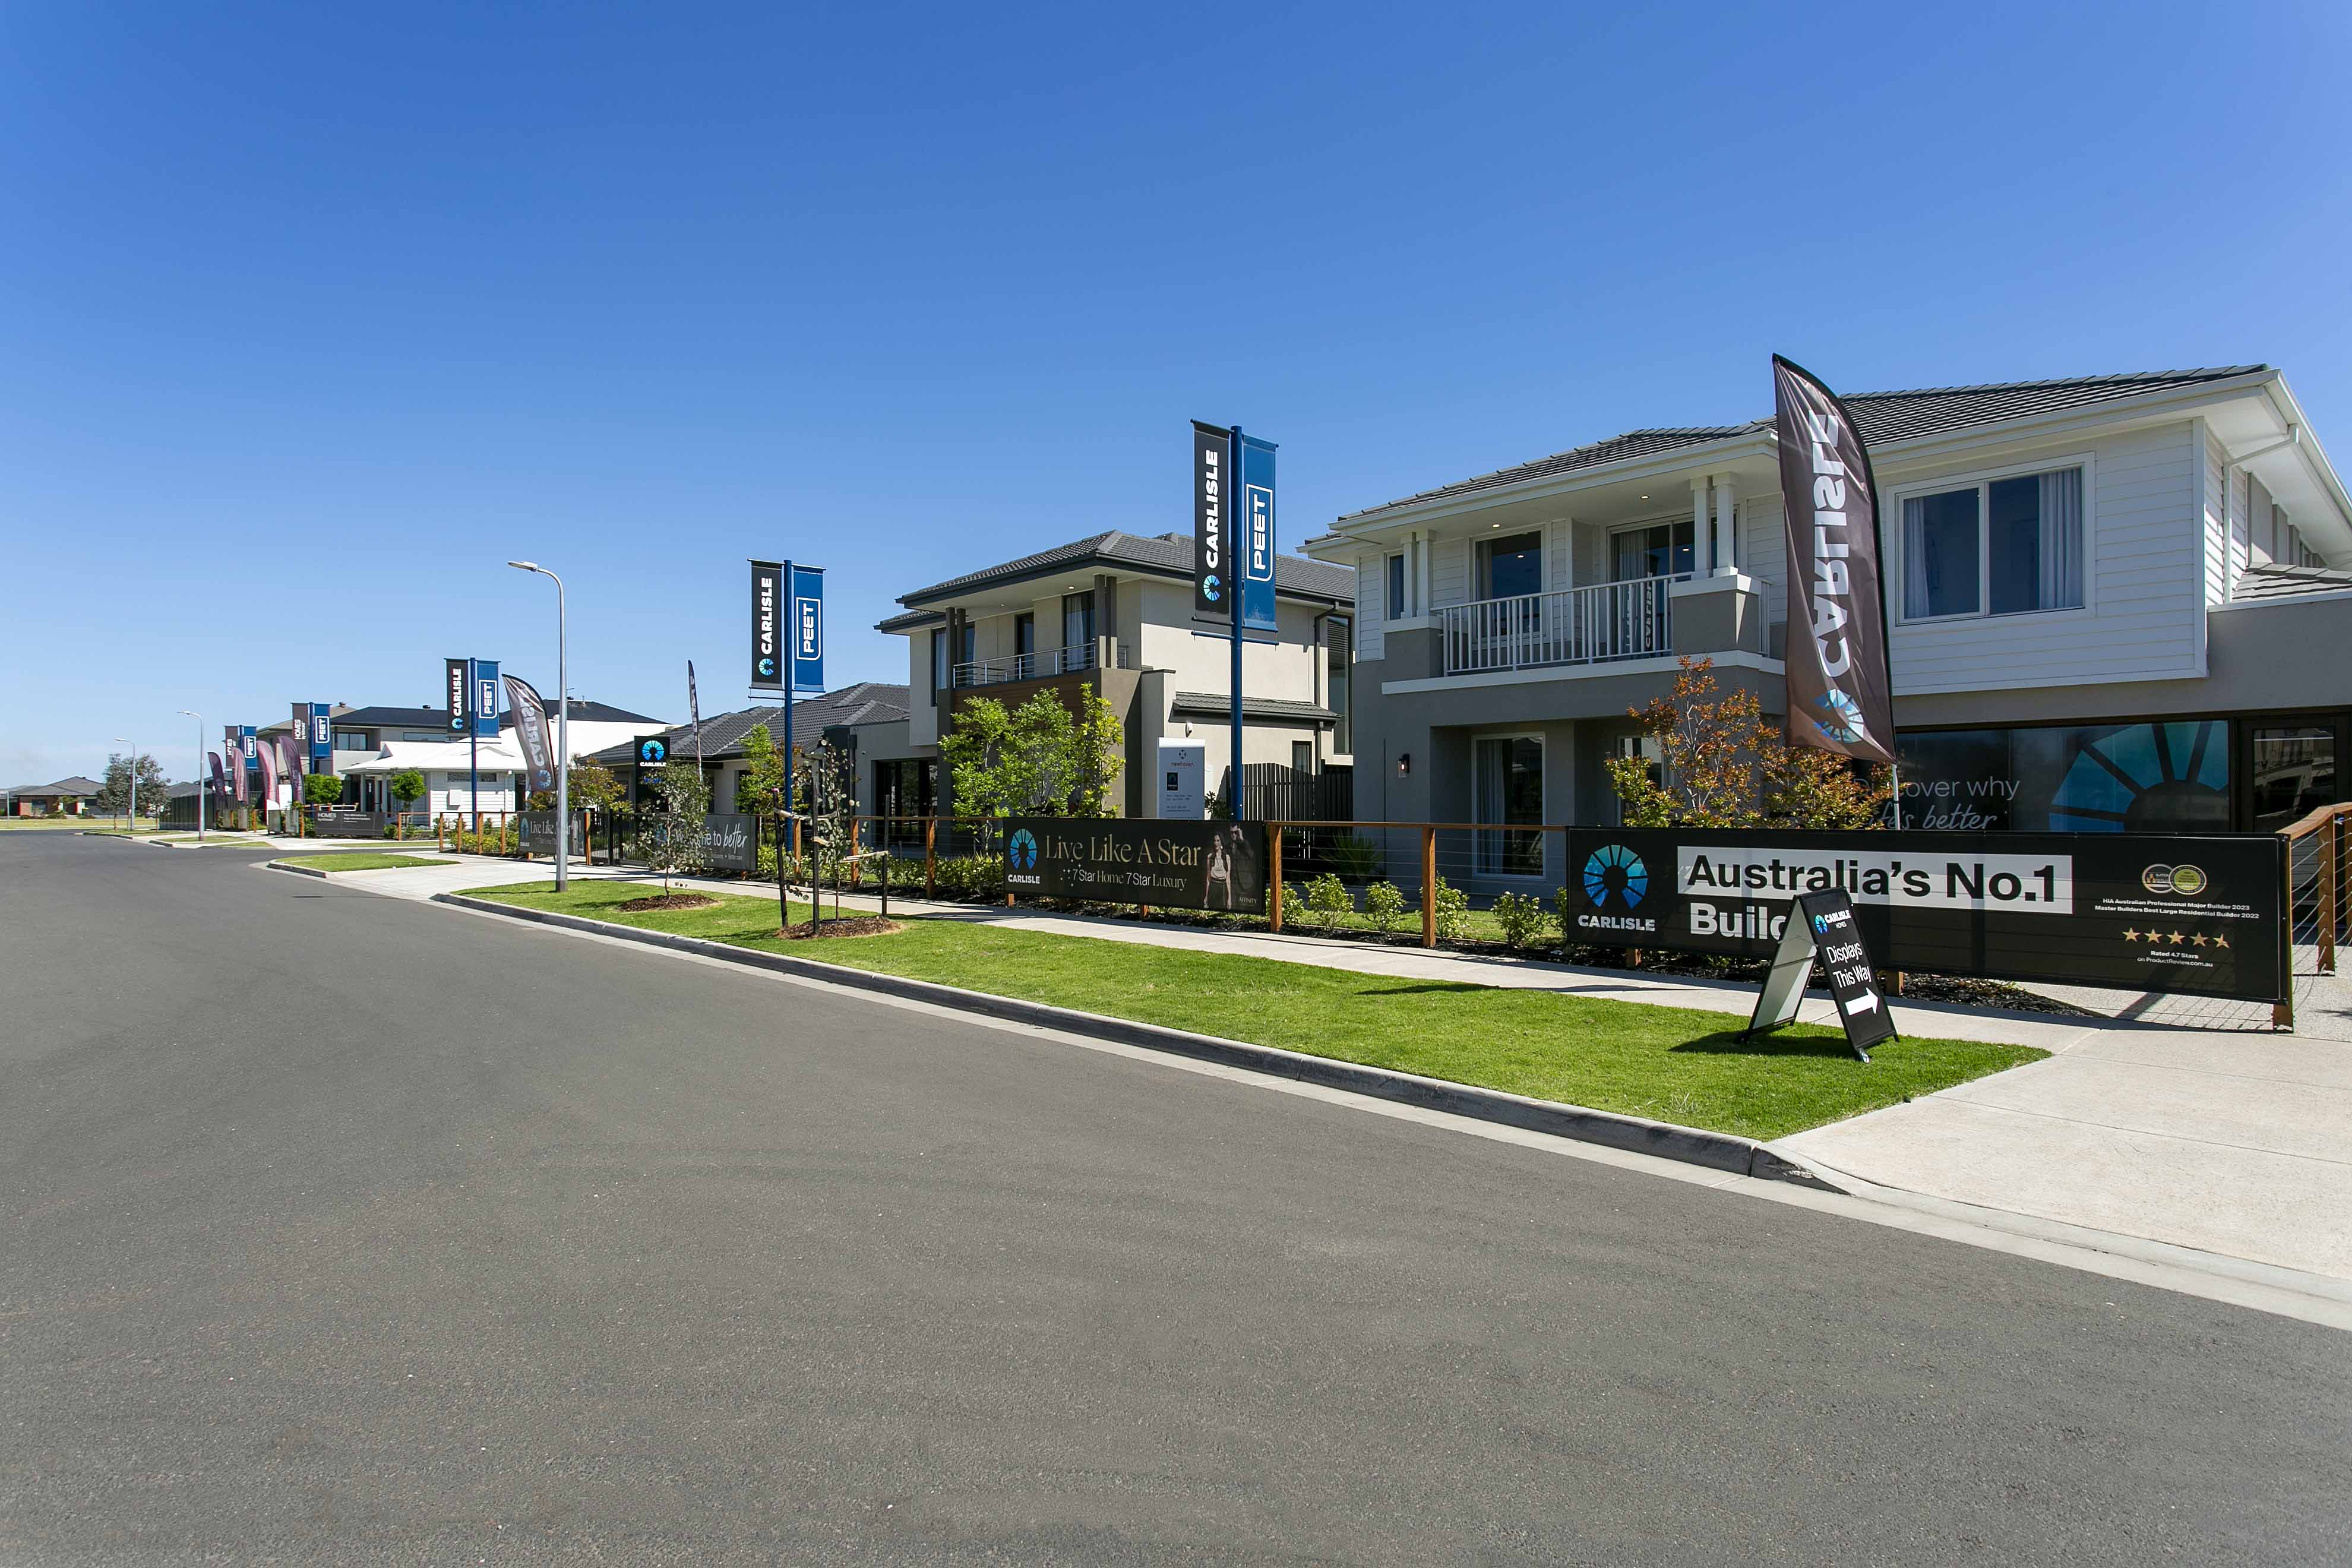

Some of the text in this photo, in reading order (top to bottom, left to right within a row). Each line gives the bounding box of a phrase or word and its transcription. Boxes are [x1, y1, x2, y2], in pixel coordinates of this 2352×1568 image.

[1206, 450, 1218, 569] CARLISLE
[1254, 494, 1266, 570] PEET
[761, 577, 773, 655] CARLISLE
[803, 603, 814, 653] PEET
[453, 668, 462, 716] CARLISLE
[483, 683, 492, 715] PEET
[1967, 776, 2020, 801] why
[1923, 803, 1997, 830] better
[713, 830, 722, 846] to
[723, 823, 748, 854] better
[1046, 834, 1201, 866] Live Like A Star
[1008, 874, 1040, 884] CARLISLE
[1073, 869, 1187, 891] 7 Star Home 7 Star Luxury
[1946, 862, 2054, 902] No.1
[1578, 914, 1655, 932] CARLISLE
[1824, 909, 1851, 924] CARLISLE
[1826, 942, 1863, 964] Displays
[2146, 957, 2213, 968] ProductReview.com.au
[1833, 964, 1872, 988] This Way
